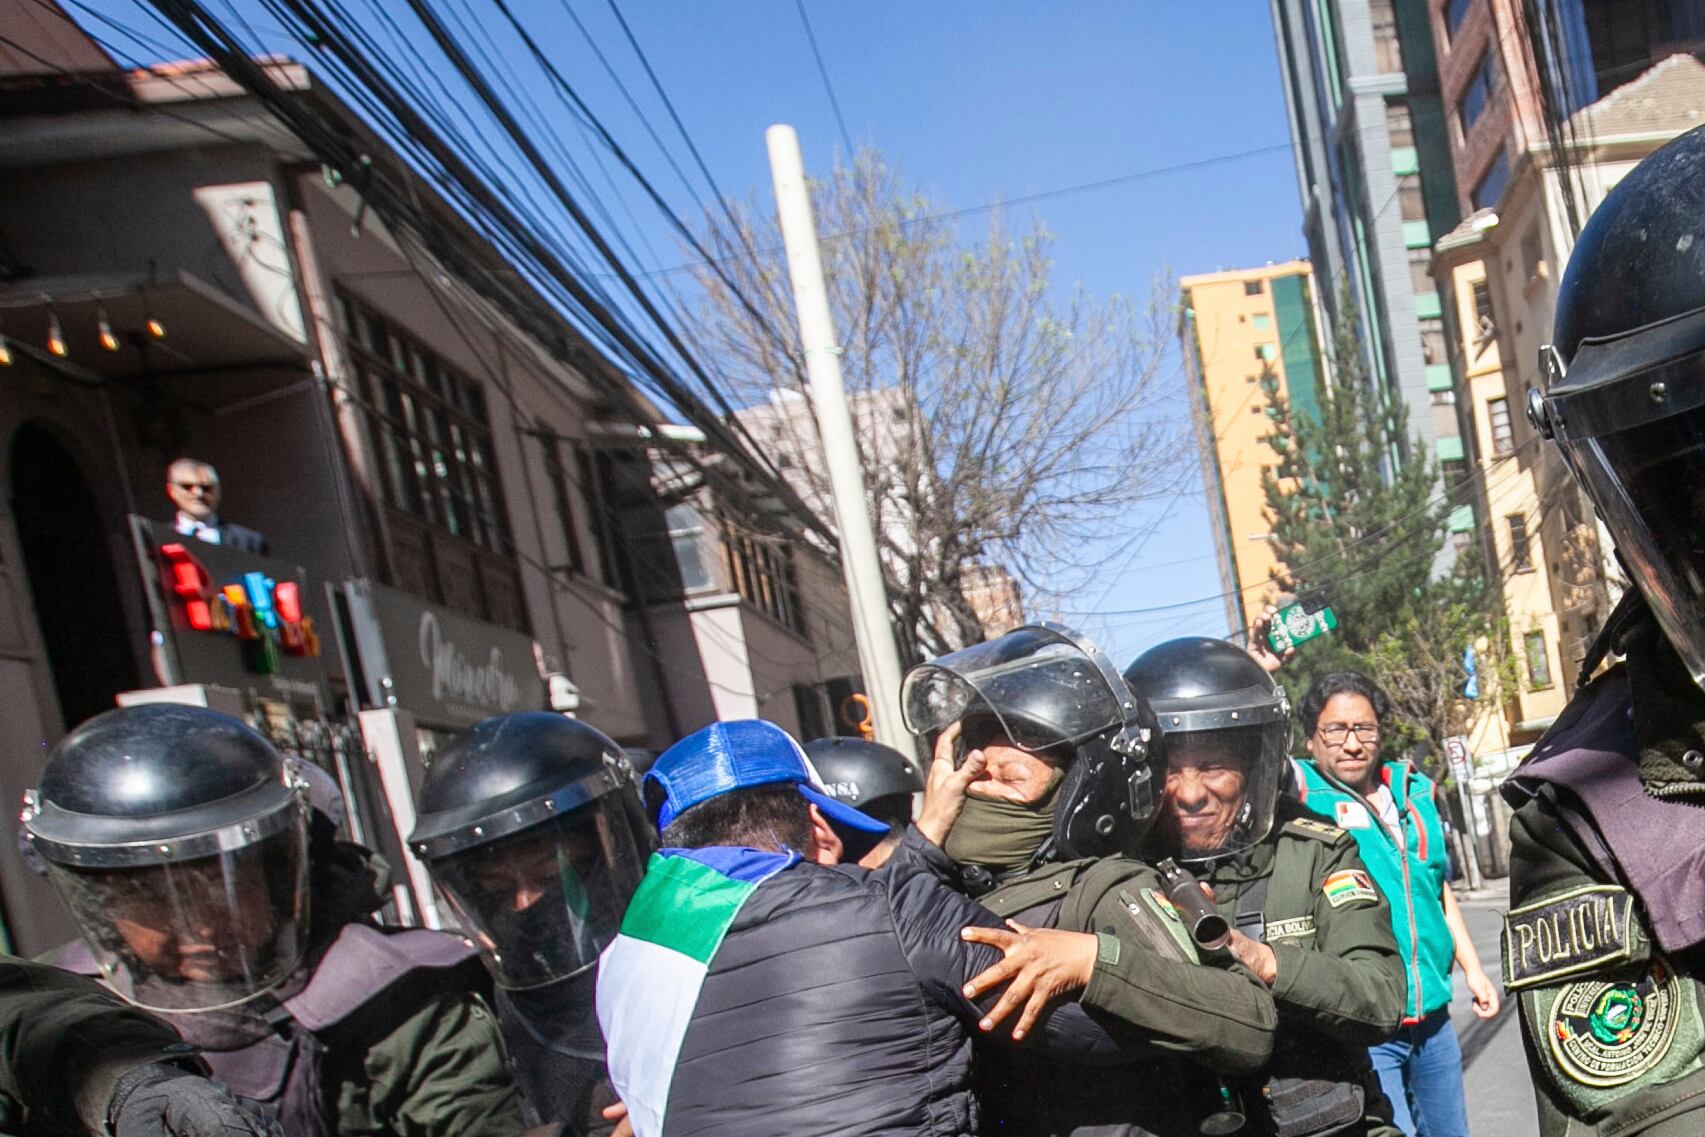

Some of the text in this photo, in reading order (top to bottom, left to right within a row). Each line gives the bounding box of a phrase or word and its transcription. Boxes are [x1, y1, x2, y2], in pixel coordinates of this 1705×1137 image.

[1514, 895, 1619, 969] POLICIA
[1568, 1039, 1591, 1066] CENTRO
[1590, 1060, 1601, 1071] DE
[1600, 1051, 1645, 1071] FORMACION
